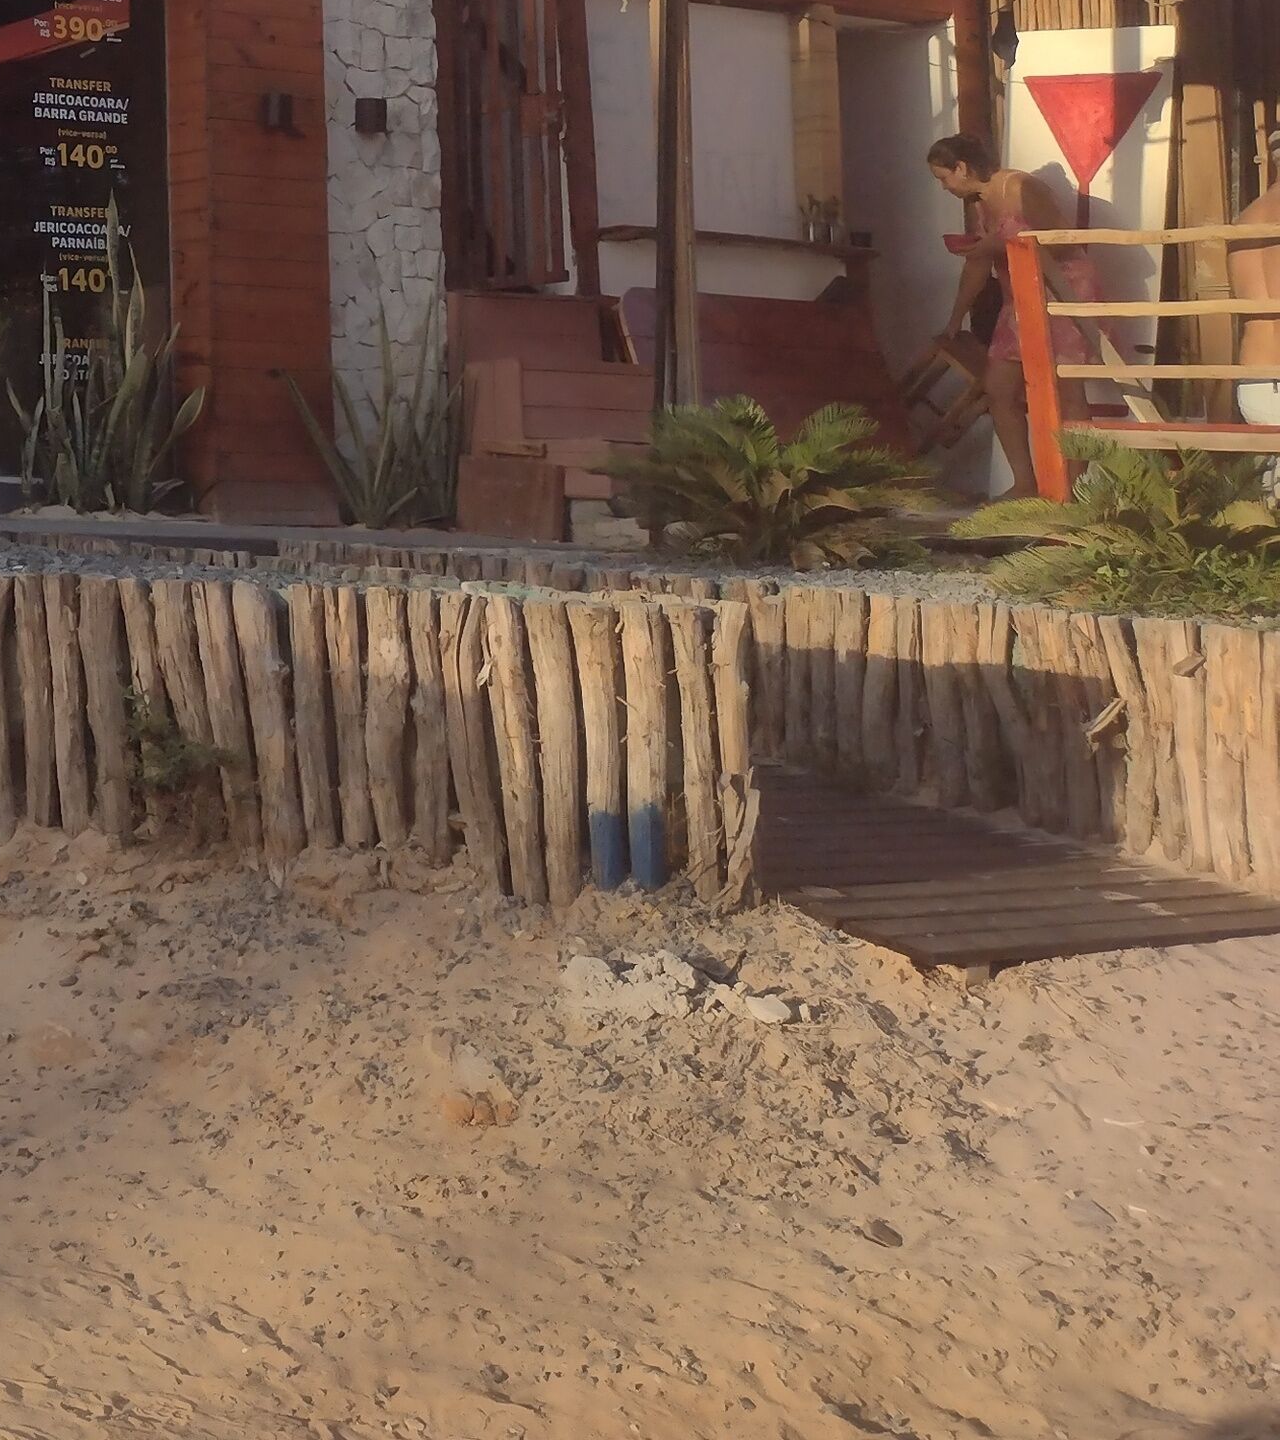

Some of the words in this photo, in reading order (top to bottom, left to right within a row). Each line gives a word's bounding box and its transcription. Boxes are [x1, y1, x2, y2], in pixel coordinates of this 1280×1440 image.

[49, 77, 112, 92] TRANSFER
[32, 92, 130, 112] JERICOACOARA/
[34, 107, 76, 121] BARRA
[79, 109, 128, 124] GRANDE
[52, 236, 108, 250] PARNAÍB
